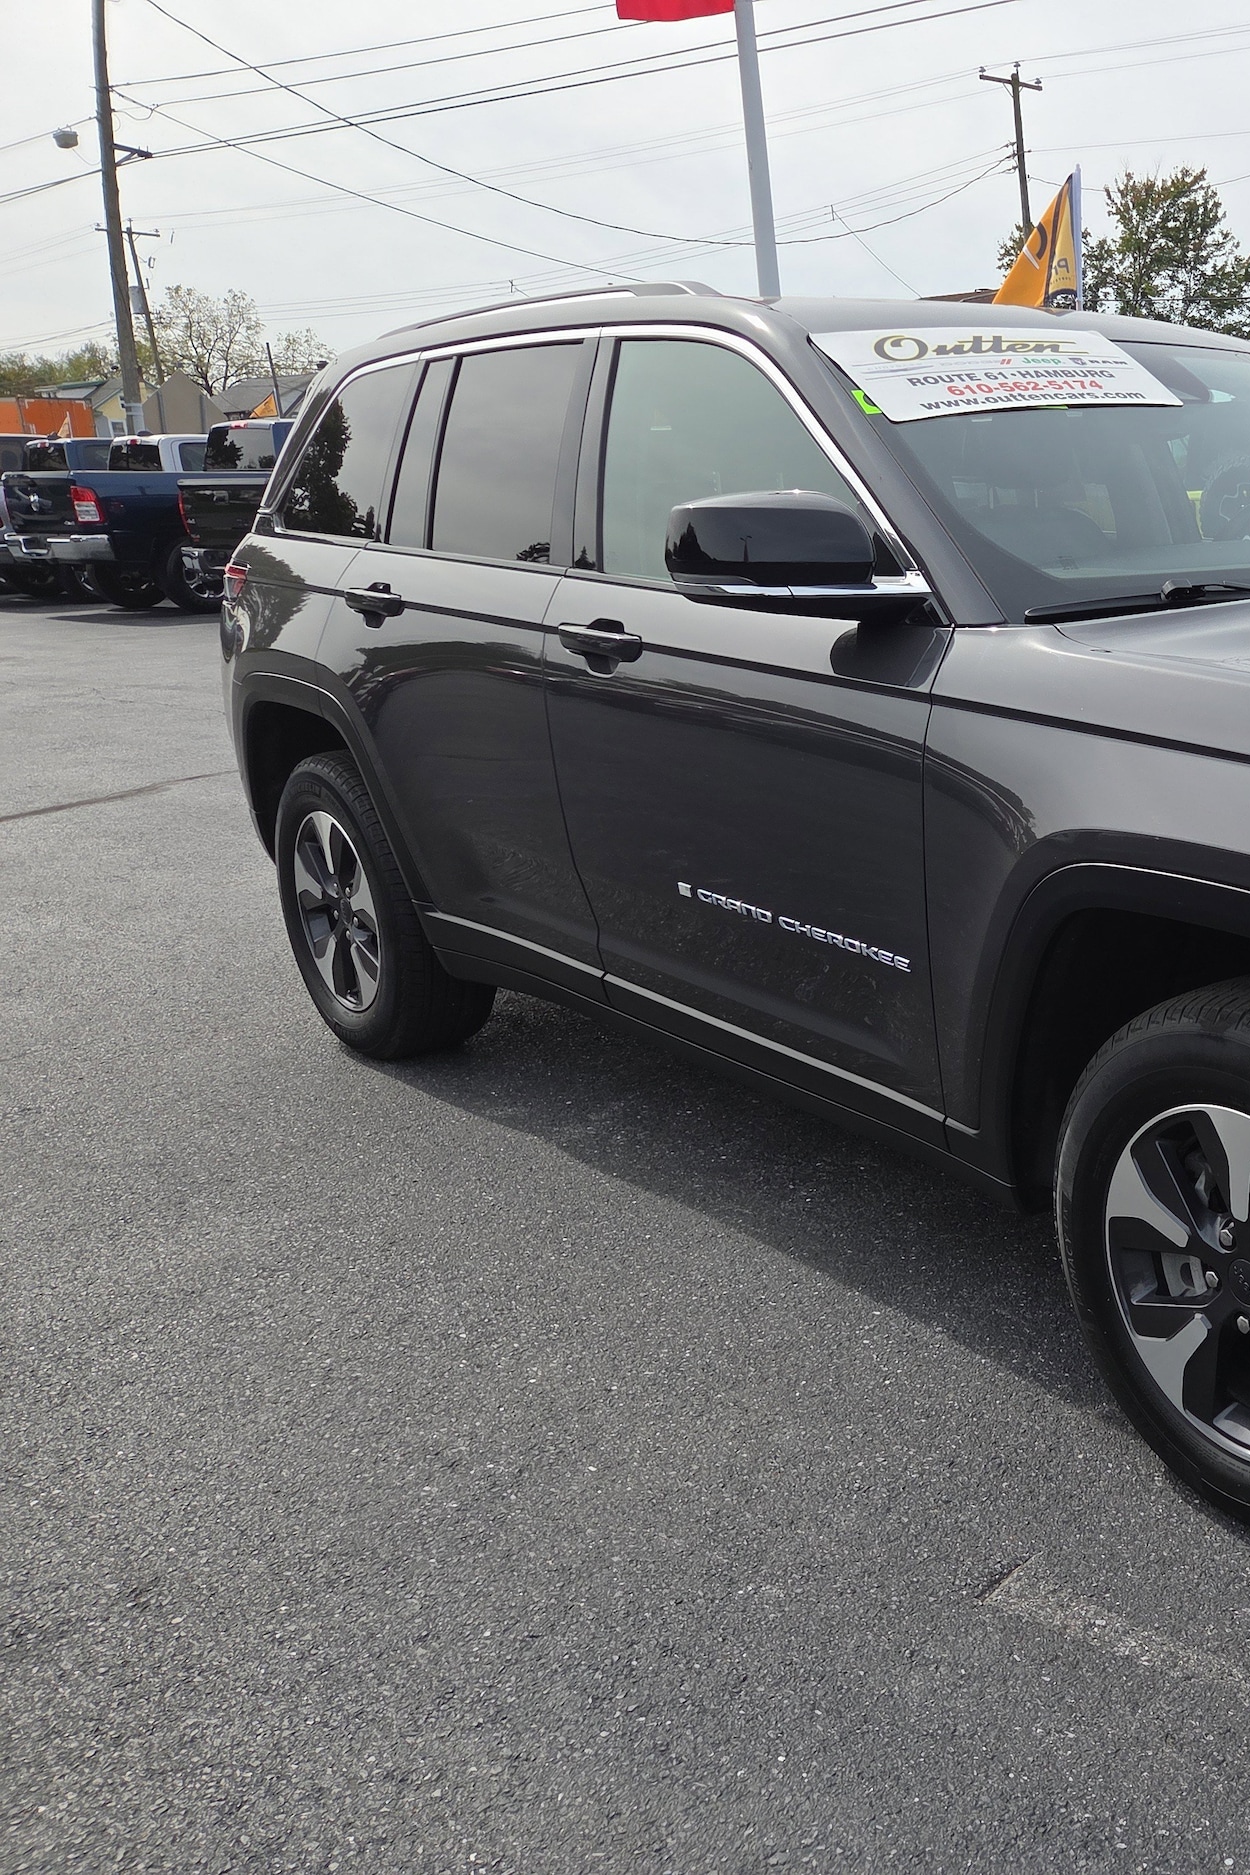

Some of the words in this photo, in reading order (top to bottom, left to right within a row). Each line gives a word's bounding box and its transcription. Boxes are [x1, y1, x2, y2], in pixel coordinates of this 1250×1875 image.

[874, 335, 1089, 361] Outten
[1022, 357, 1061, 365] Jeep
[907, 373, 981, 386] ROUTE
[947, 380, 1103, 396] 610-562-5174
[920, 392, 1147, 410] www.outtencars.com
[697, 889, 772, 923] GRAND
[778, 916, 911, 972] CHEROKEE
